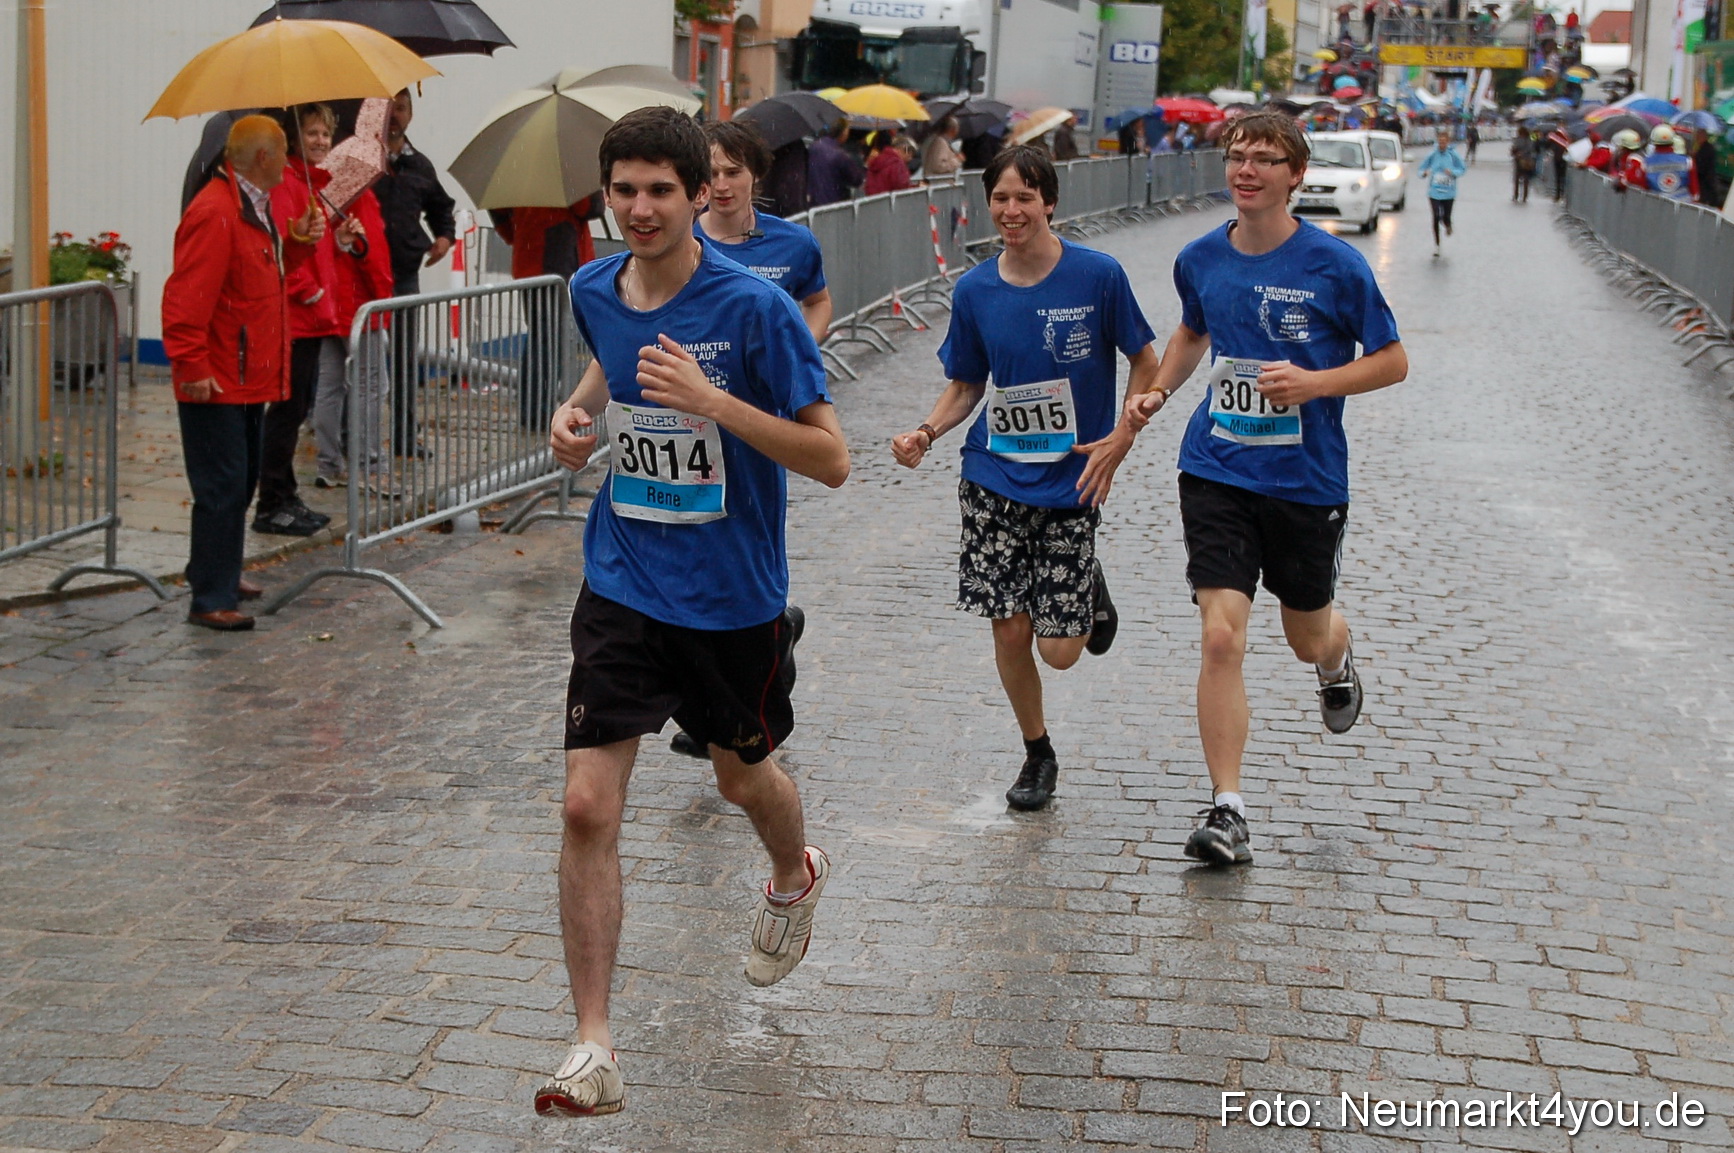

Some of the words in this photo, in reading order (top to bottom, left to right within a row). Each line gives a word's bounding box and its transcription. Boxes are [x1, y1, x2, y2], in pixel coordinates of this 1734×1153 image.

[849, 1, 924, 19] BOCK
[1425, 50, 1476, 63] START
[1253, 285, 1264, 293] 12.
[1265, 286, 1315, 299] NEUMARKTER
[1263, 293, 1304, 303] STADTLAUF
[1047, 313, 1086, 322] STADTLAUF
[1048, 306, 1095, 316] NEUMARKTER
[1232, 363, 1263, 375] BOC
[1005, 387, 1042, 401] BOCK
[632, 413, 678, 428] BOCK
[992, 401, 1068, 434] 3015
[1229, 418, 1277, 434] Michael
[1016, 437, 1050, 451] David
[618, 432, 713, 481] 3014
[646, 485, 682, 508] Rene
